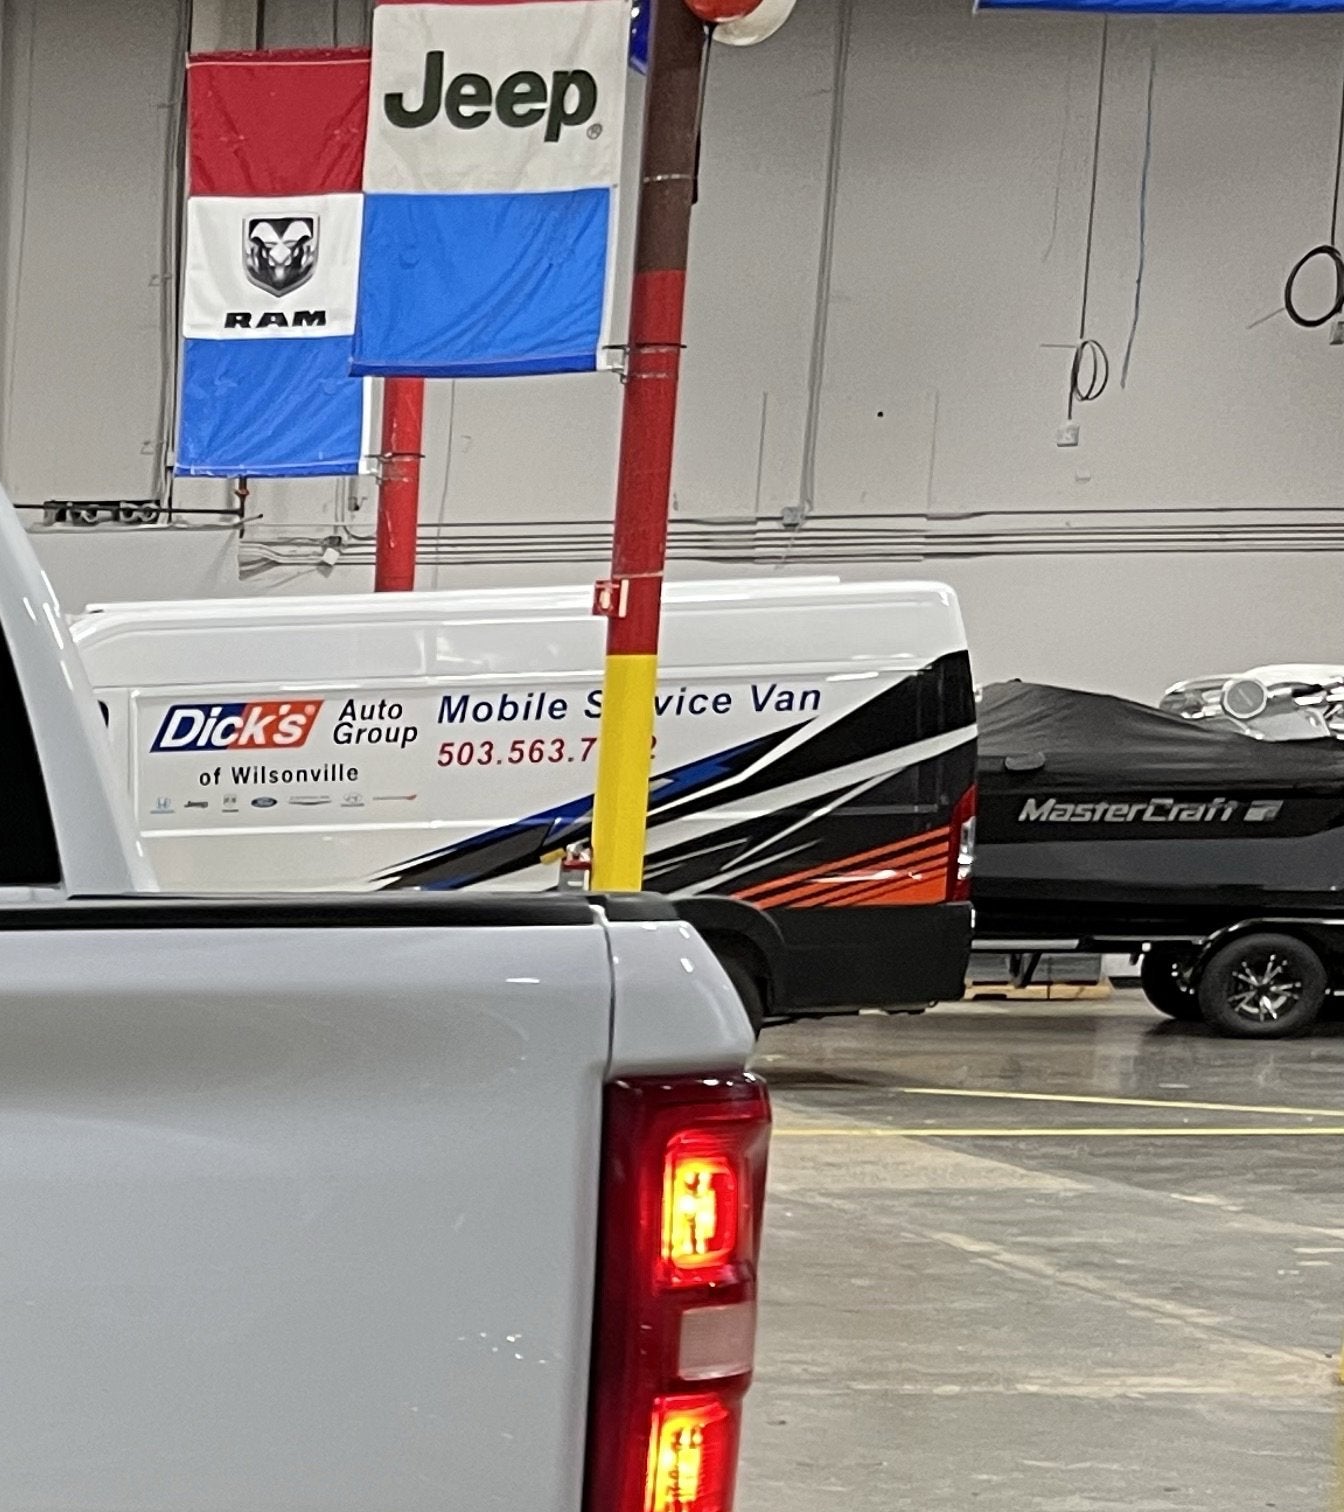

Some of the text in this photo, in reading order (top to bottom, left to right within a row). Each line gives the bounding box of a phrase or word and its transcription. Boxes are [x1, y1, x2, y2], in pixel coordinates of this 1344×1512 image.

[383, 50, 598, 142] Jeep
[223, 309, 327, 329] RAM
[436, 682, 823, 724] Mobile Svice Van
[159, 698, 404, 749] Dick's Auto
[333, 721, 418, 749] Group
[199, 763, 360, 786] of Wilsonville
[1018, 797, 1238, 822] MasterCraft
